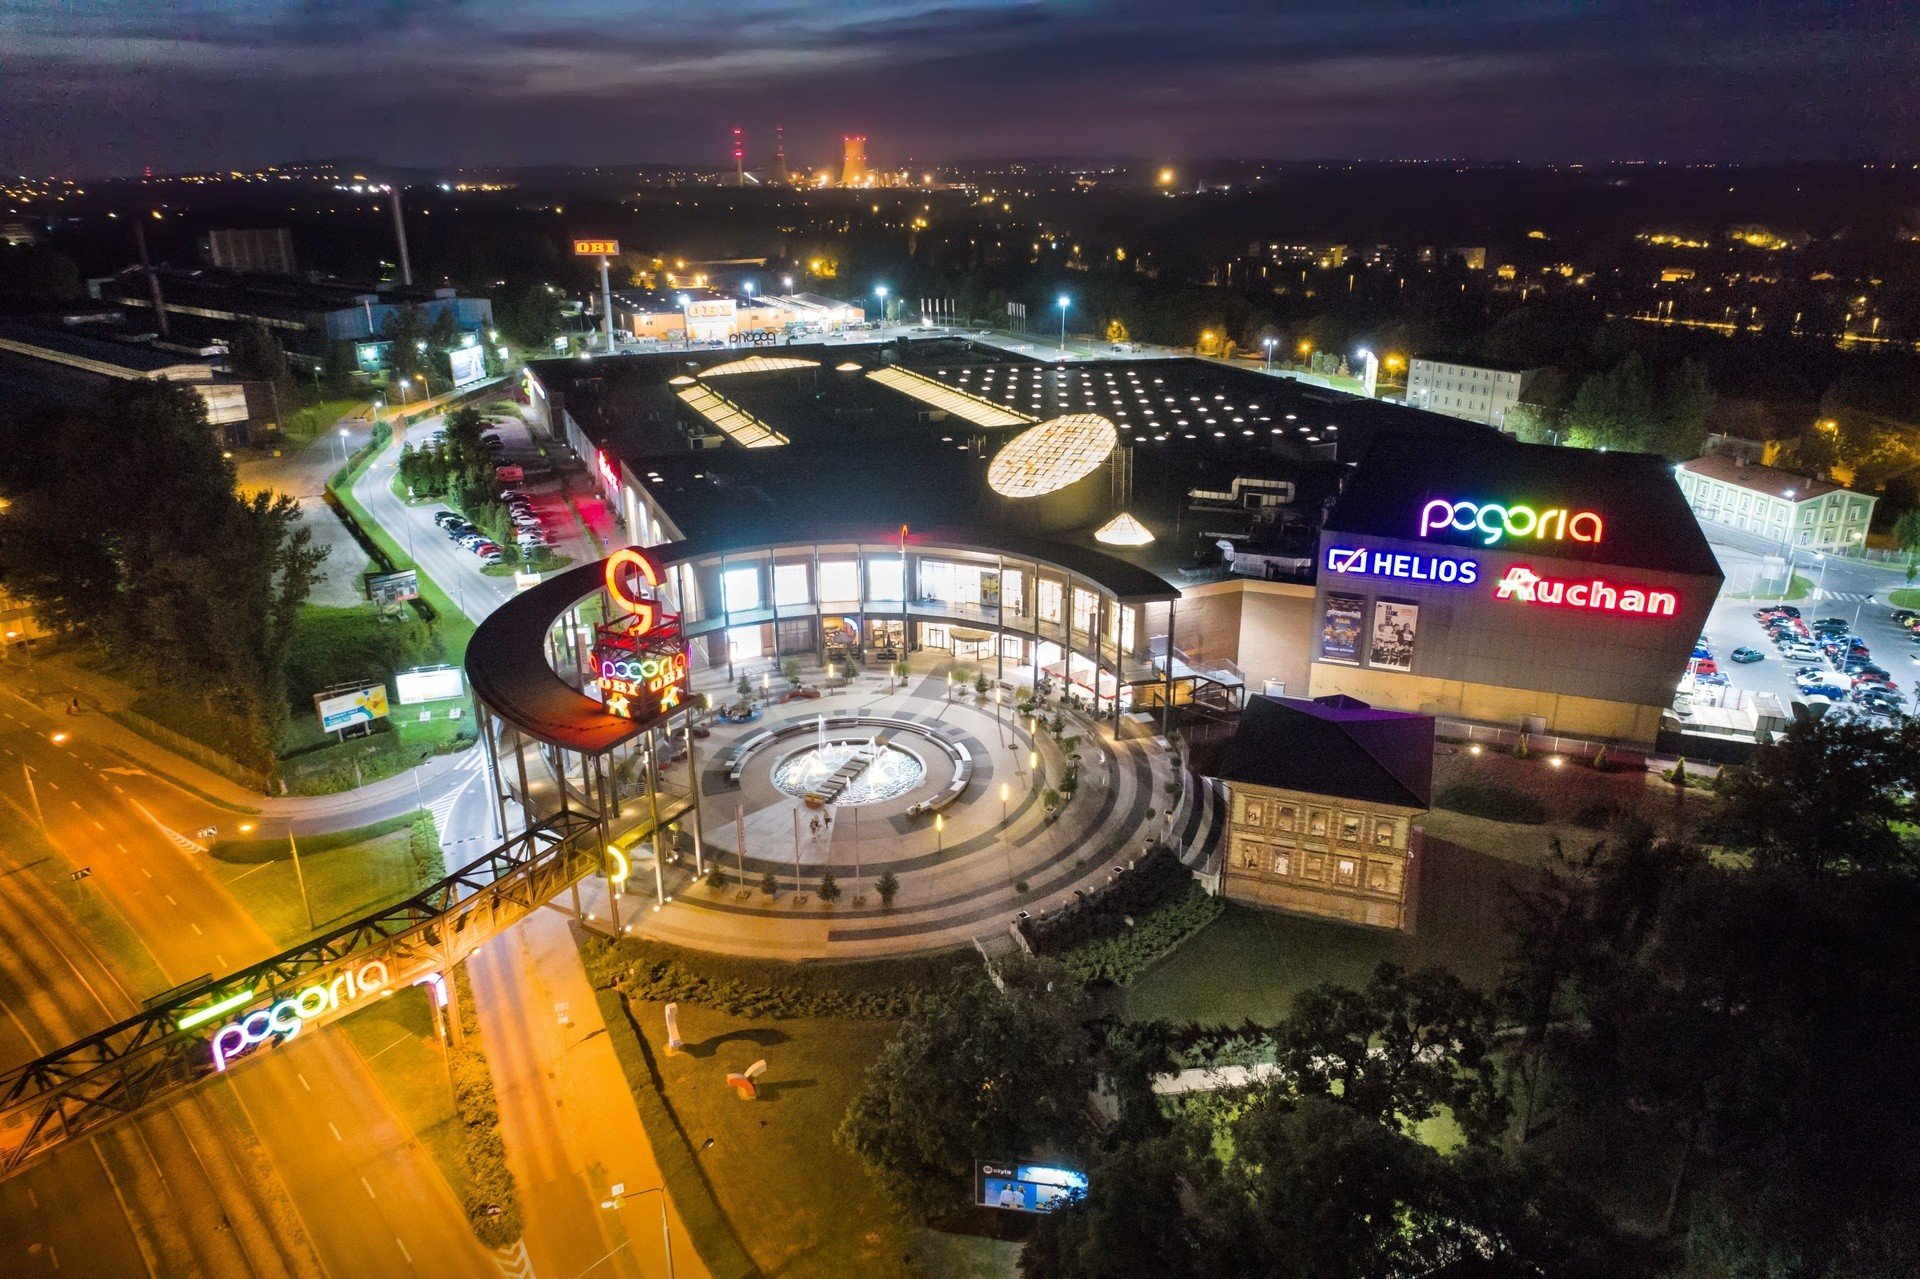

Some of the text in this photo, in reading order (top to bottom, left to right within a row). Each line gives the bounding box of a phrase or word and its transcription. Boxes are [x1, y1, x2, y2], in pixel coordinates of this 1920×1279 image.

[576, 241, 616, 254] OBI
[688, 304, 732, 318] OBI
[1419, 499, 1604, 545] pogoria
[1373, 552, 1478, 585] HELIOS
[1496, 567, 1677, 616] Auchan
[602, 653, 687, 685] pogoria
[649, 668, 686, 693] OBI
[597, 675, 639, 697] OBI
[212, 961, 389, 1073] pogoria
